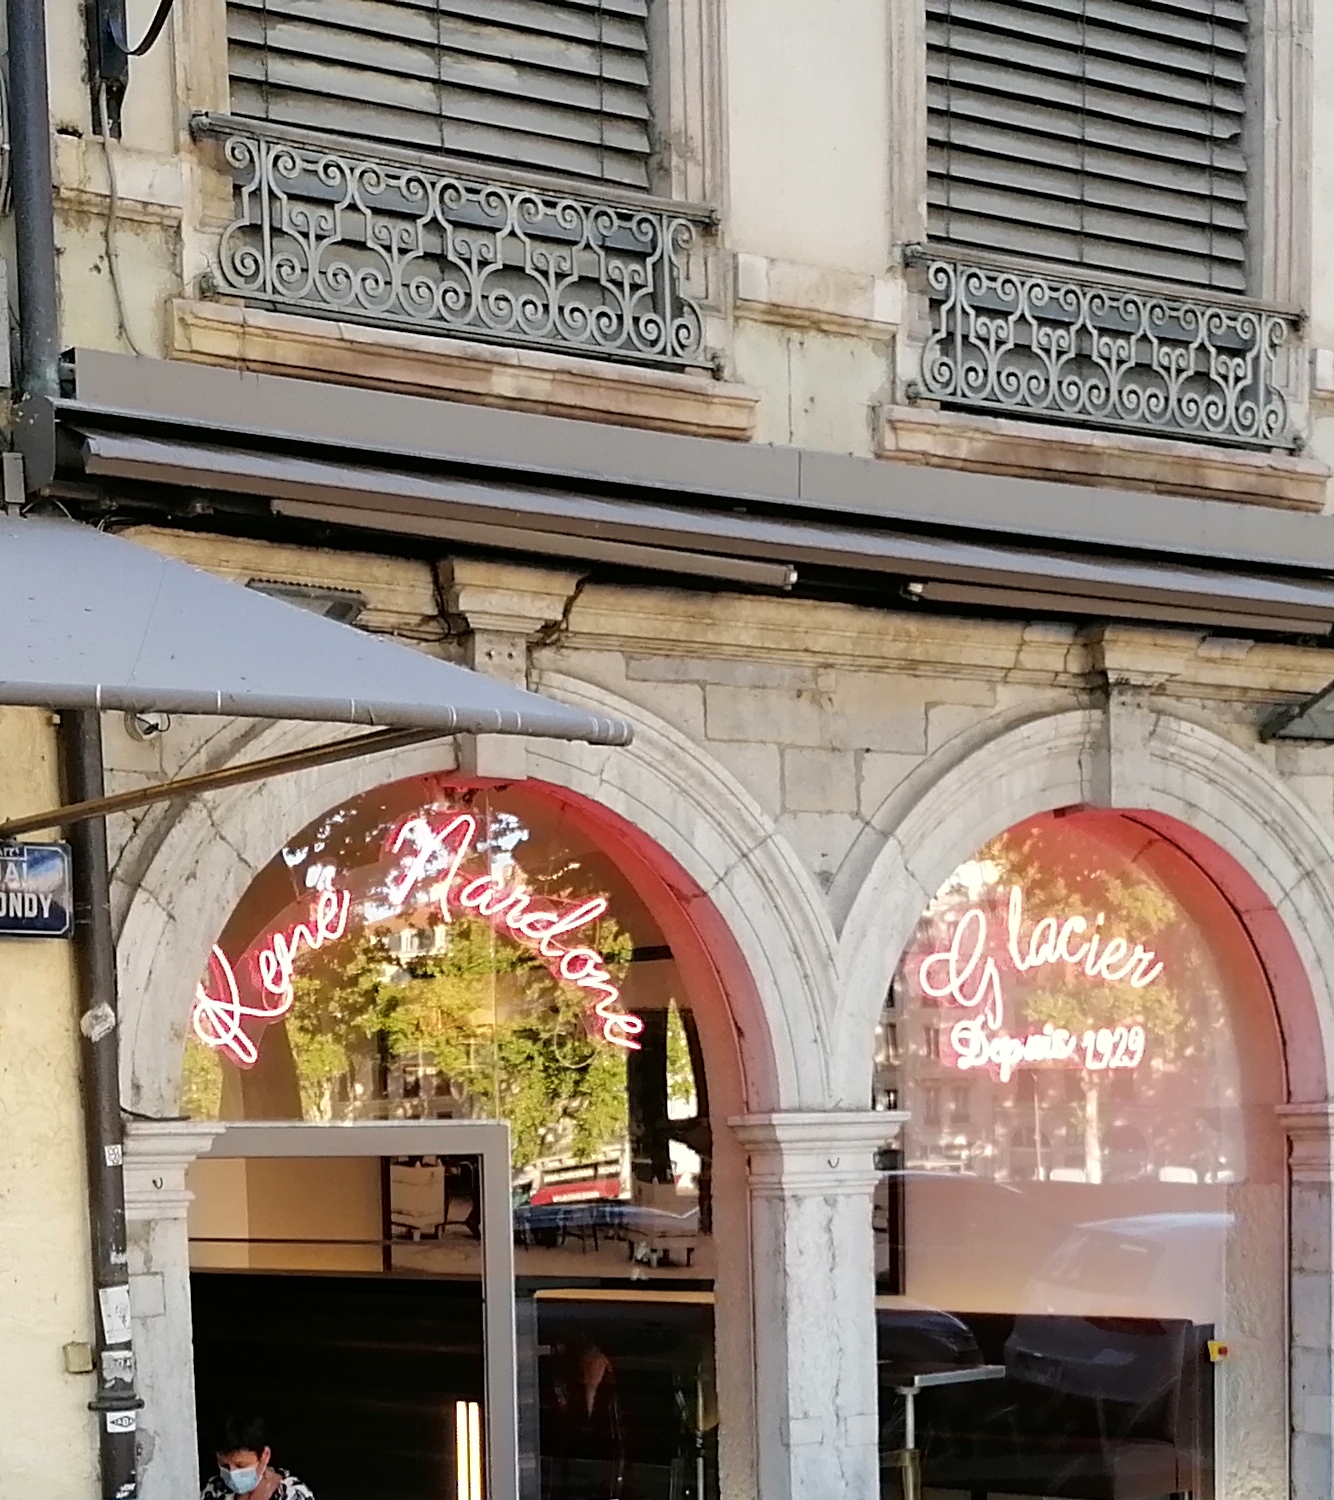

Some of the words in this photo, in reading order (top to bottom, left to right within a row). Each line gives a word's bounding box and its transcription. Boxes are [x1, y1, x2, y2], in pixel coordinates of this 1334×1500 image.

[391, 812, 645, 1051] Nardone
[918, 885, 1164, 1030] Glacier
[951, 1020, 1077, 1083] Depuis
[1081, 1026, 1146, 1070] 1929
